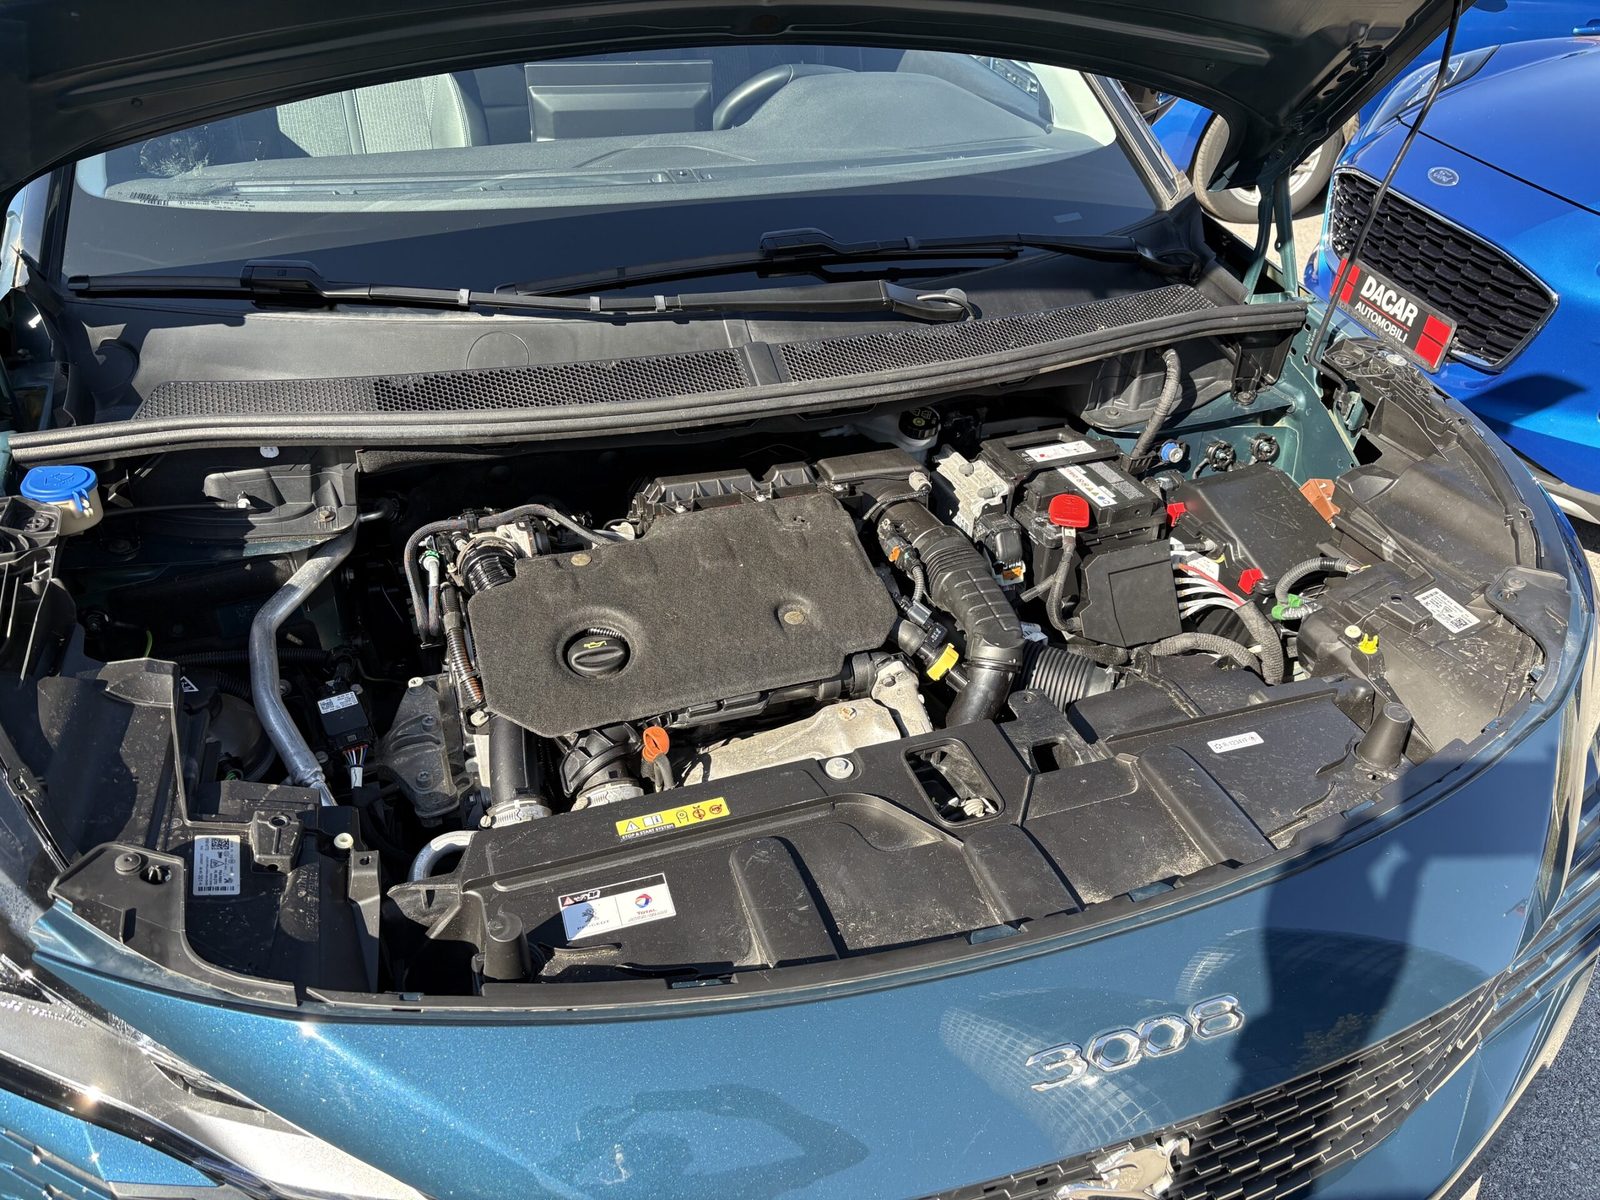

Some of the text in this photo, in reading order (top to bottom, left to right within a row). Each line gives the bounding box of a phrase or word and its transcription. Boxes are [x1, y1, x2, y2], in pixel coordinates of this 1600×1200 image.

[1355, 301, 1409, 343] AUTOMOBILI
[1360, 275, 1419, 327] DACAR
[621, 831, 636, 840] STOP
[640, 828, 655, 836] START
[1025, 993, 1245, 1092] 3008
